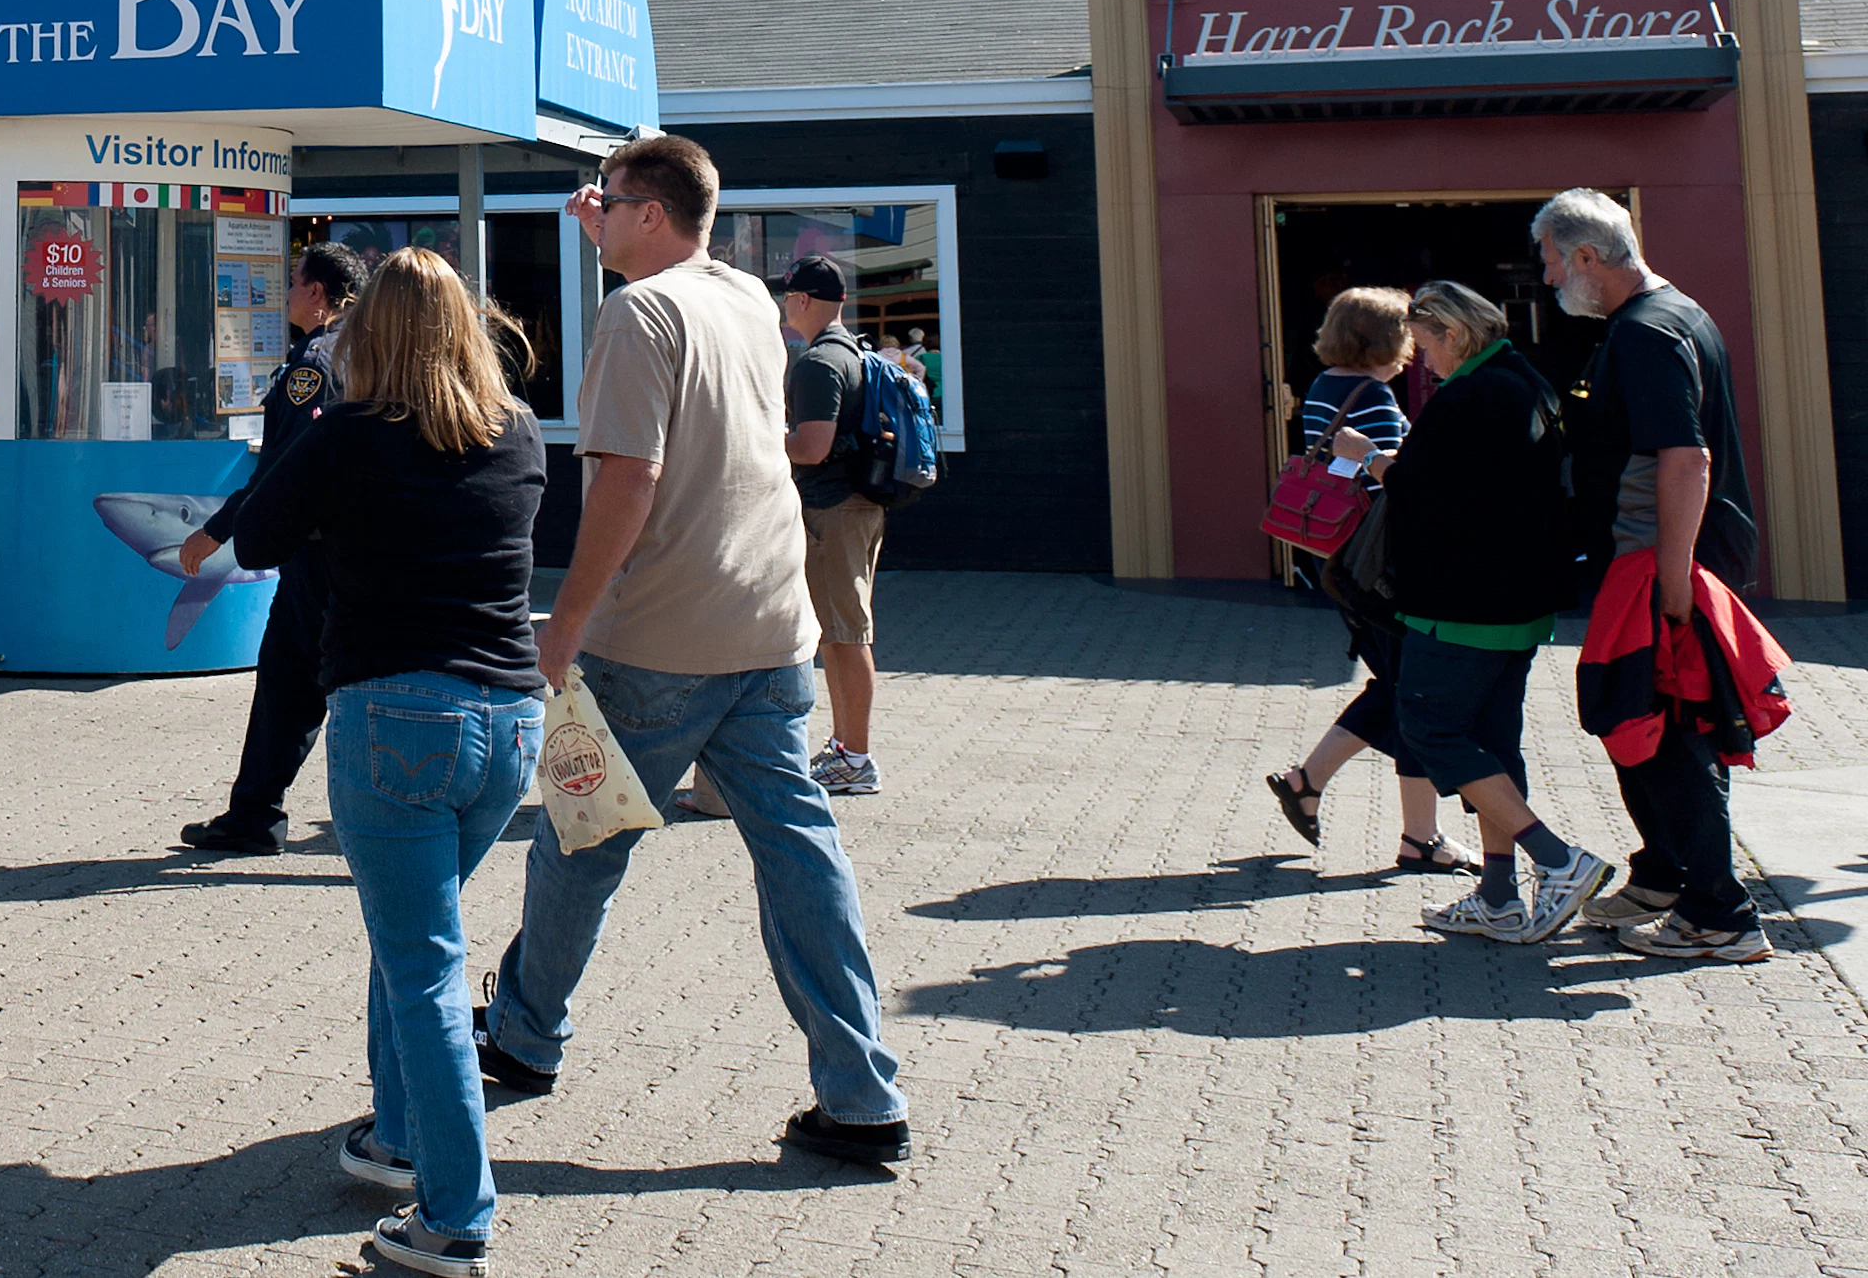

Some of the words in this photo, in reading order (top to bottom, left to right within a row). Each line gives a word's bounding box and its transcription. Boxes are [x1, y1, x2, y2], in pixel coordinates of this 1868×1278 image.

[0, 19, 98, 63] THE
[1193, 7, 1353, 61] Hard
[1373, 0, 1513, 55] Rock
[566, 31, 637, 91] ENTRANCE
[85, 134, 203, 167] Visitor
[45, 265, 84, 275] Children
[46, 243, 82, 264] $10
[42, 278, 49, 288] &
[51, 277, 87, 288] Seniors
